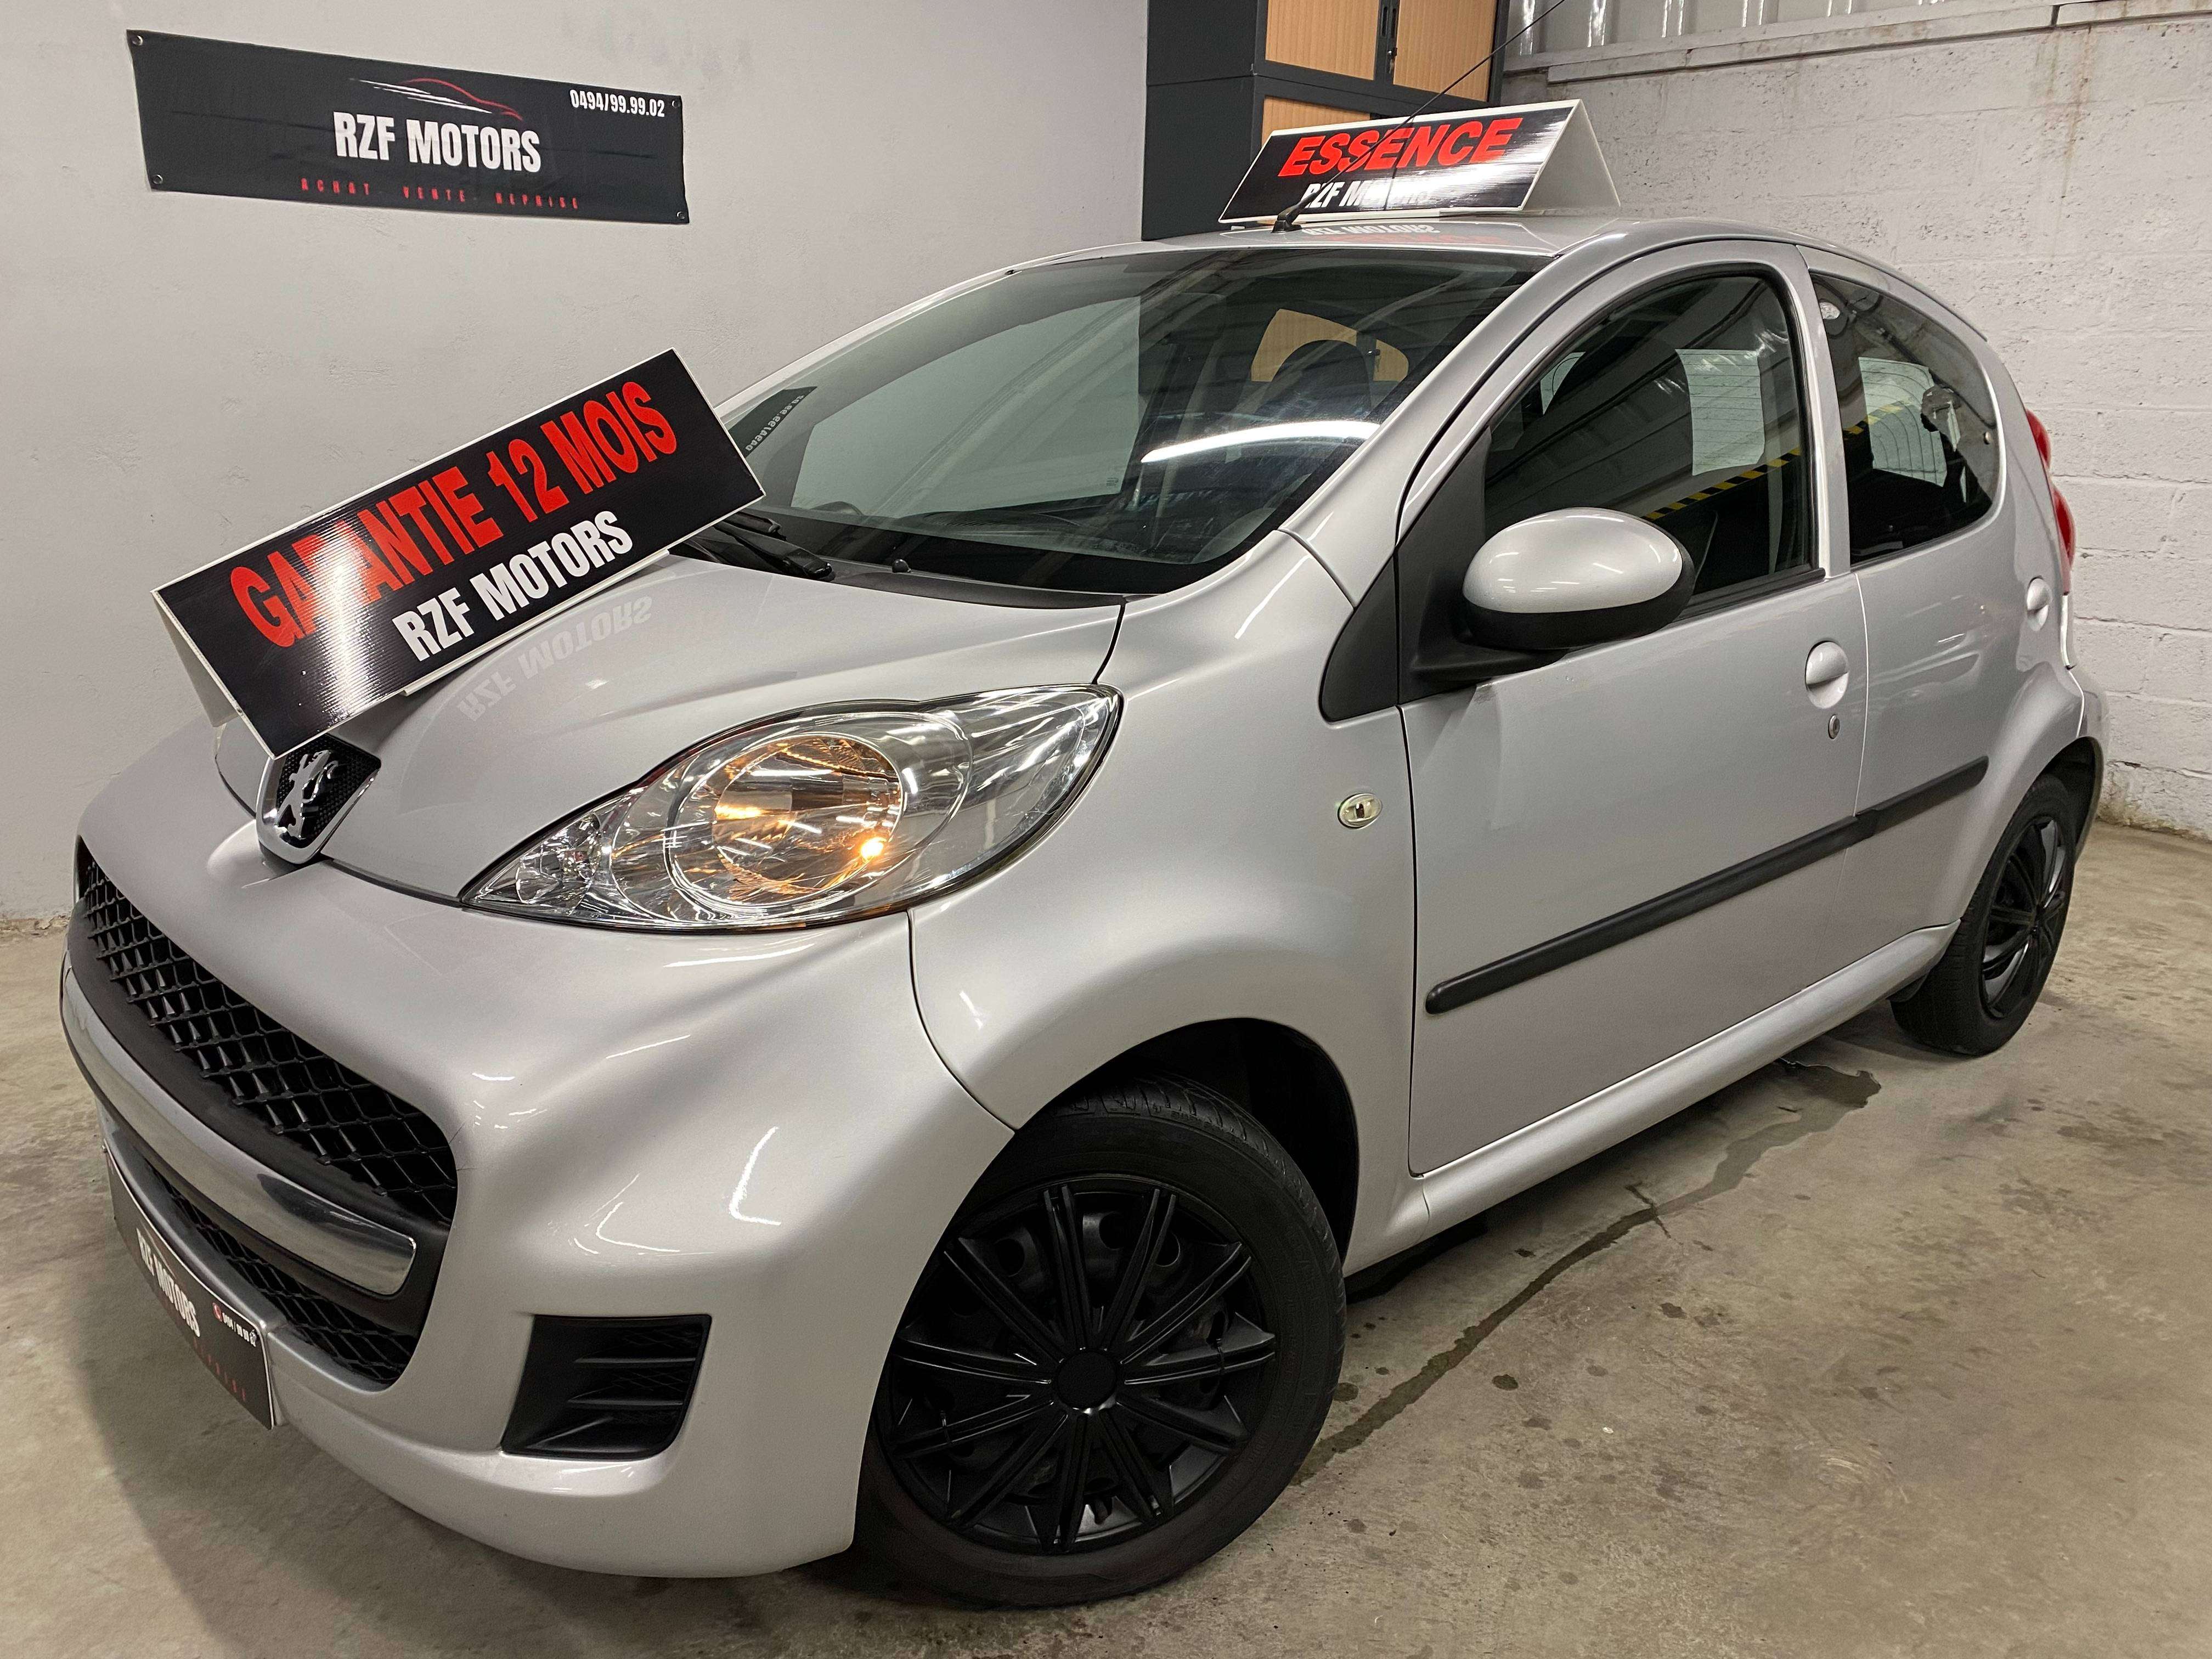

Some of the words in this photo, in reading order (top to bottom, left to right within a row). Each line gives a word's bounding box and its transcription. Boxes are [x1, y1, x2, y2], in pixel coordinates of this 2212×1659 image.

[569, 89, 665, 117] 0494/99.99.02
[333, 111, 396, 161] RZF
[406, 119, 541, 173] MOTORS
[1278, 117, 1523, 176] ESSENCE
[486, 438, 570, 523] 12
[540, 381, 678, 495] MOIS
[392, 587, 475, 662] RZF
[469, 510, 634, 621] MOTORS
